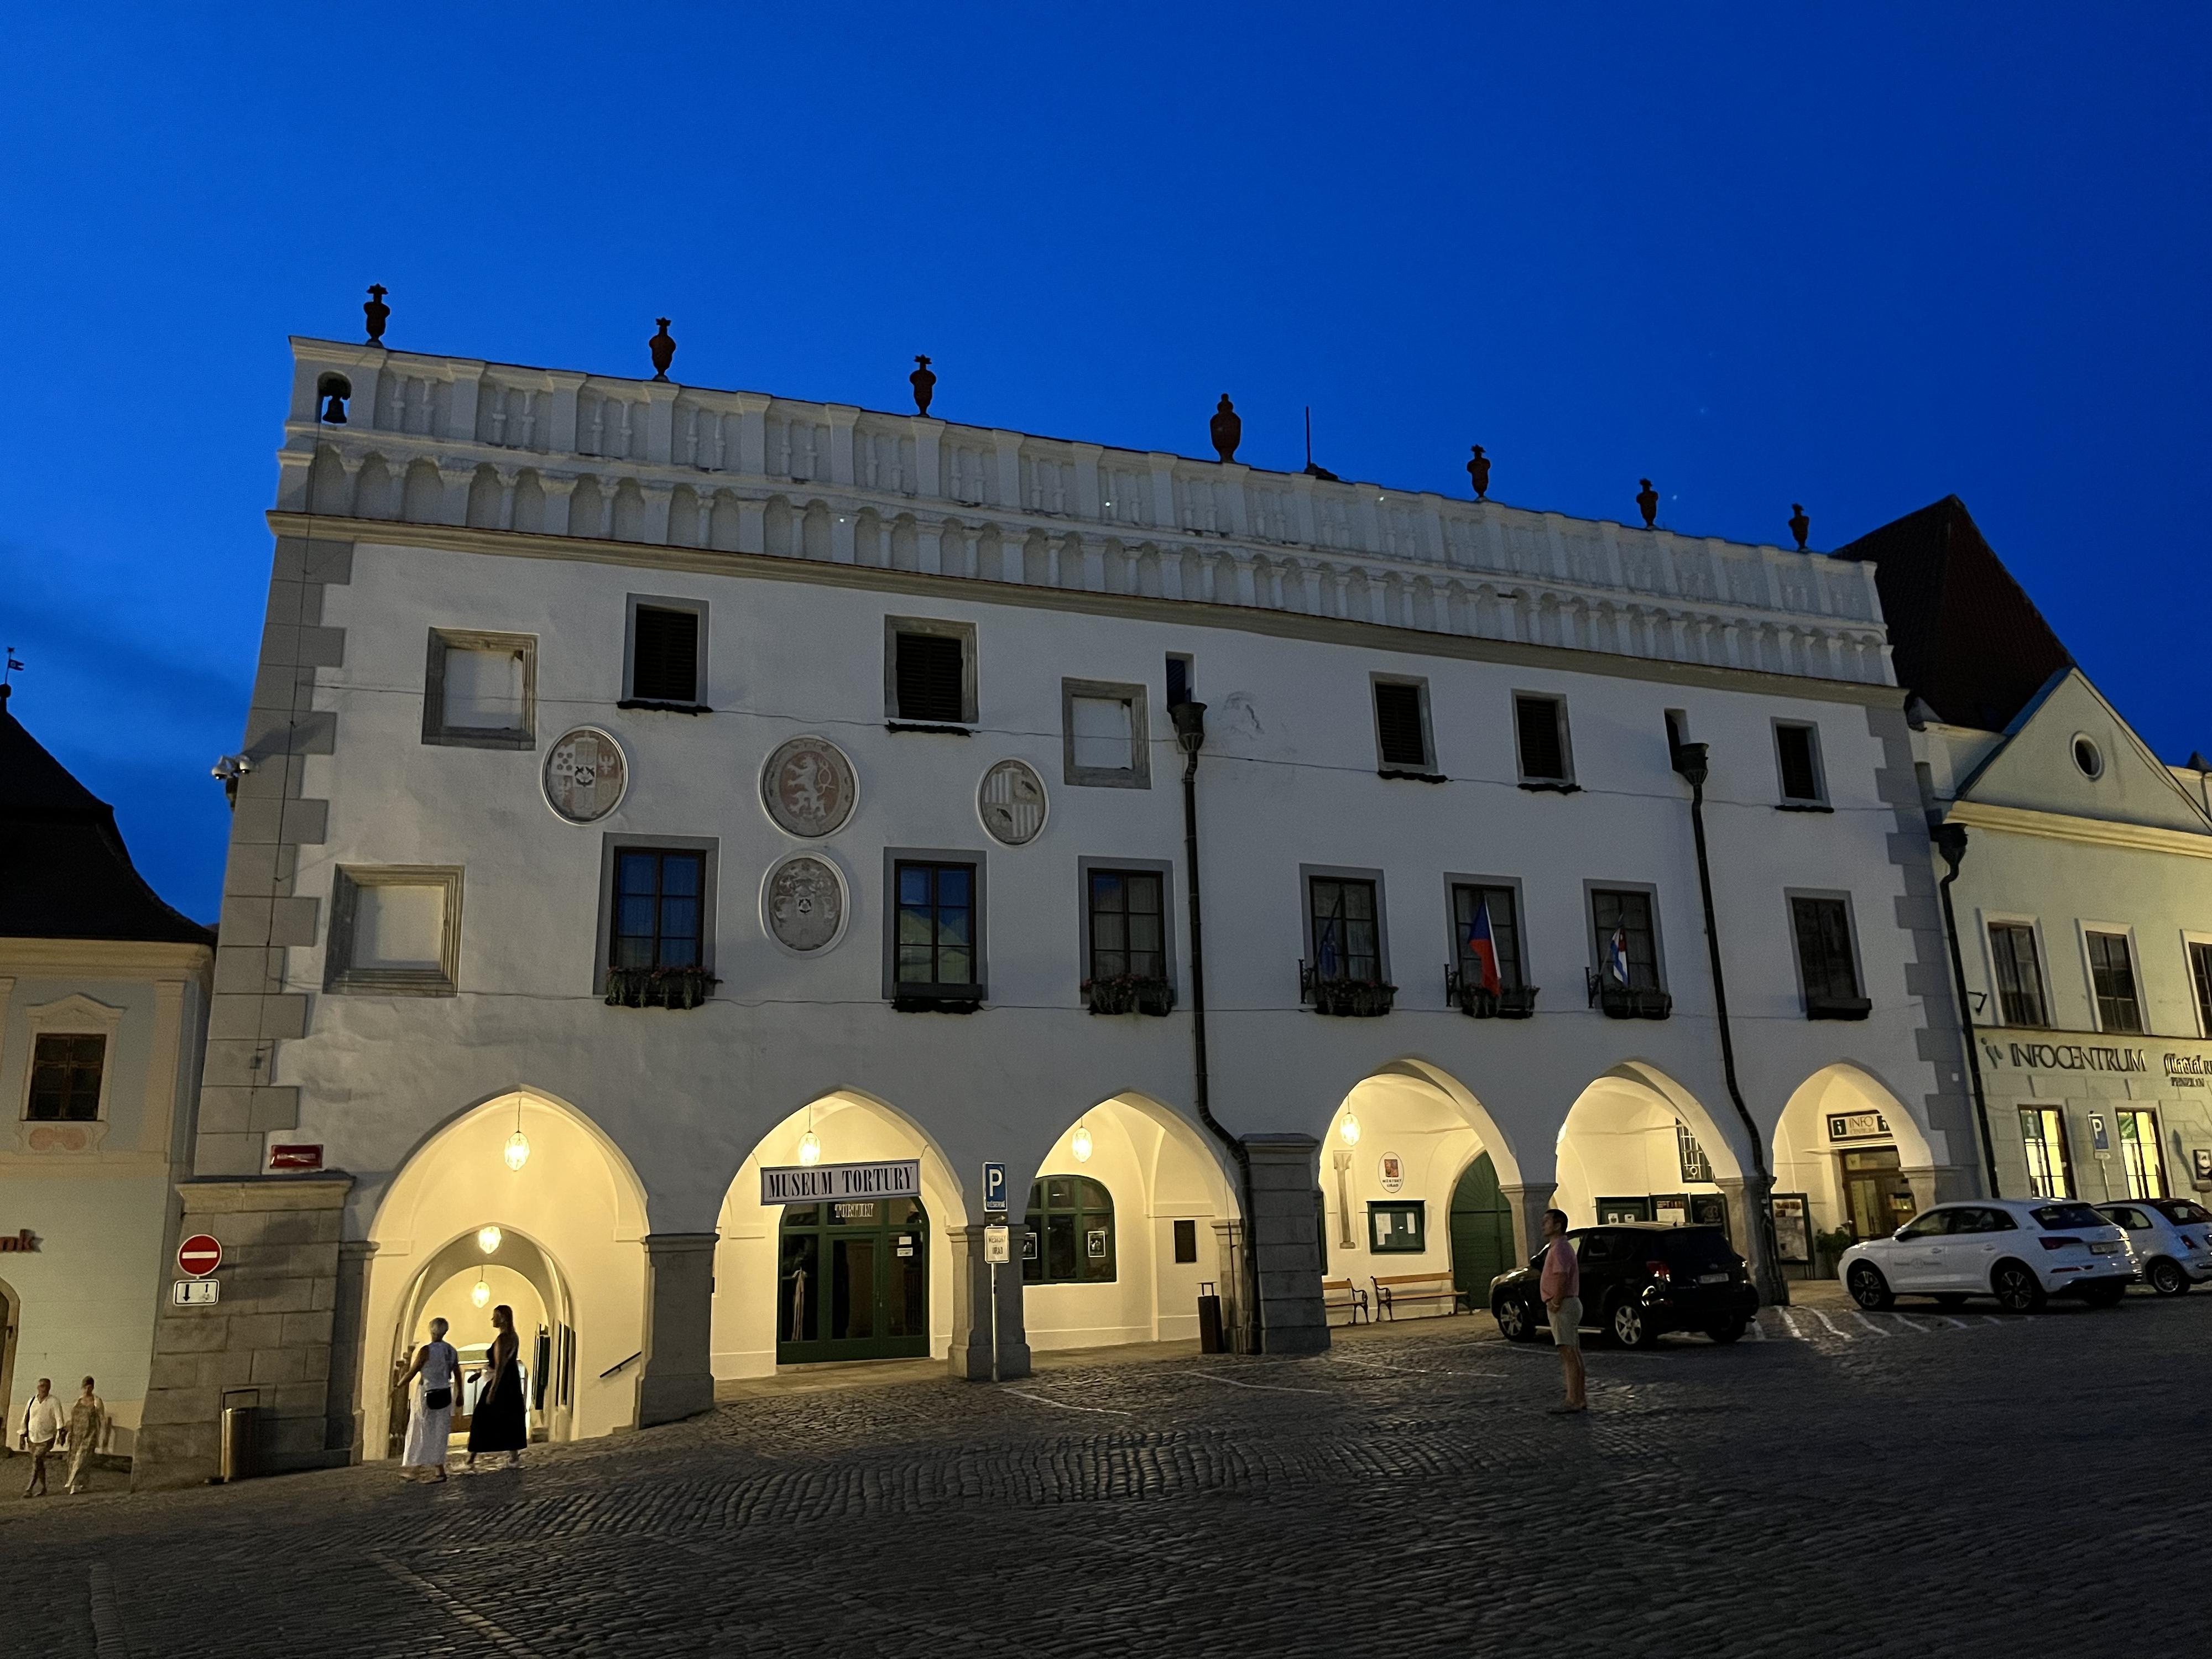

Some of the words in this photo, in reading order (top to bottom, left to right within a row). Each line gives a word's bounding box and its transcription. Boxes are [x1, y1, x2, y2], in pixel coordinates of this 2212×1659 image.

[2009, 1043, 2146, 1072] INFOCENTRUM
[1849, 1116, 1874, 1128] INFO
[2093, 1119, 2103, 1139] P
[769, 1171, 832, 1198] MUSEUM
[842, 1166, 913, 1193] TORTURY
[989, 1168, 1003, 1197] P
[834, 1203, 874, 1218] TORTURY
